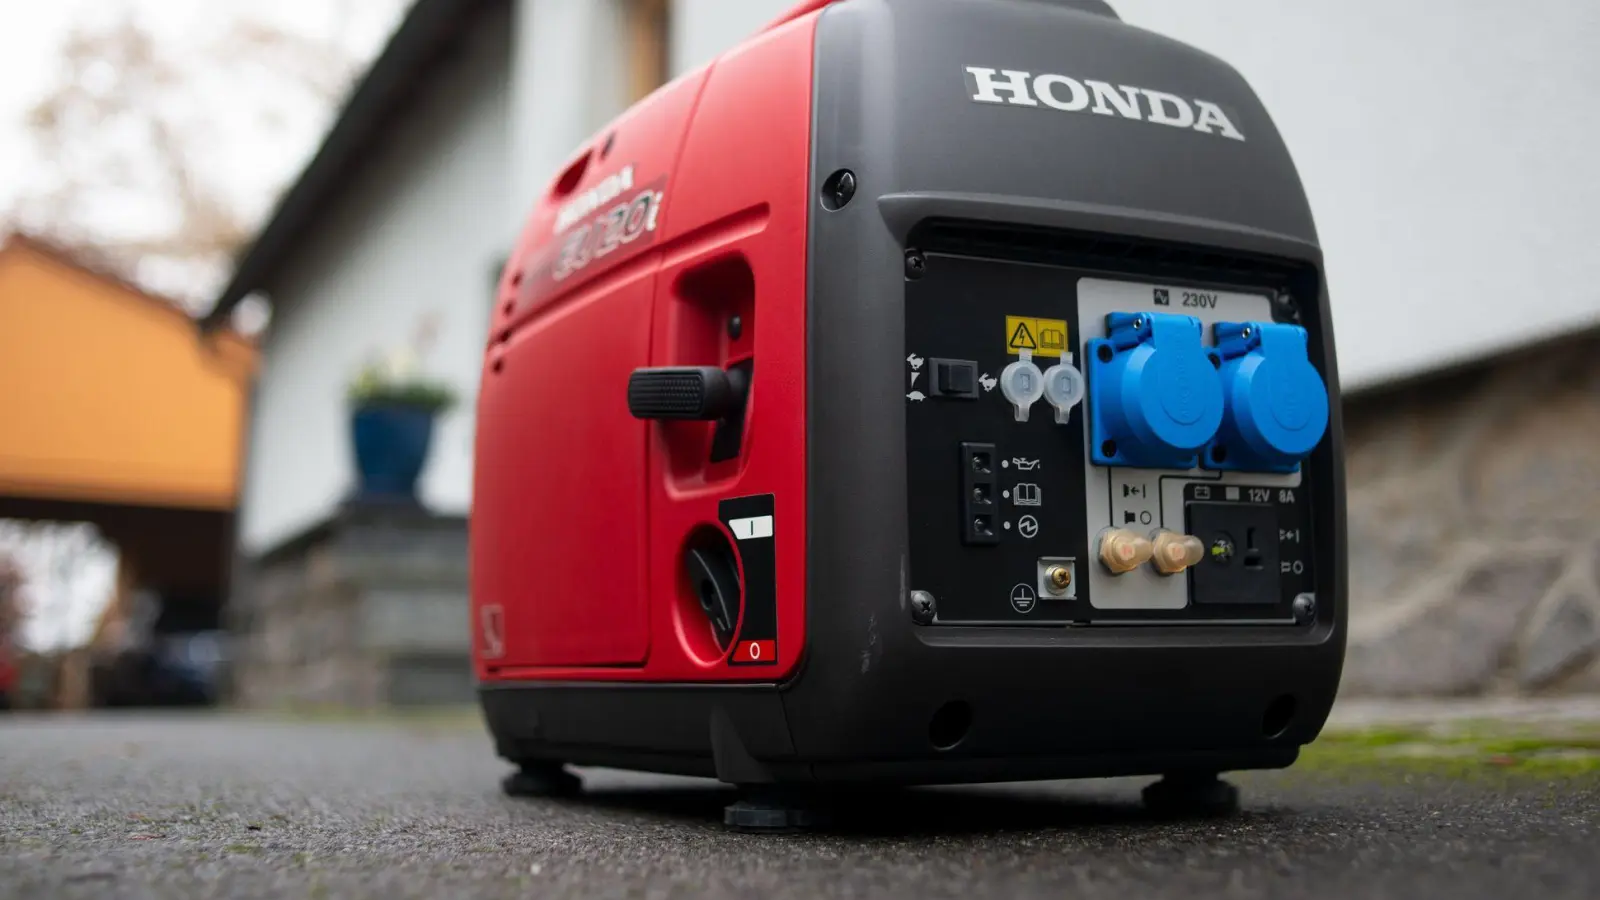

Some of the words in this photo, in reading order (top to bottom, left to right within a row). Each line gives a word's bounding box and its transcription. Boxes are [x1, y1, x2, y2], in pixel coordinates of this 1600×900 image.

[966, 66, 1246, 142] HONDA
[1182, 291, 1218, 309] 230V
[1248, 488, 1270, 502] 12V
[1279, 489, 1295, 503] 8A
